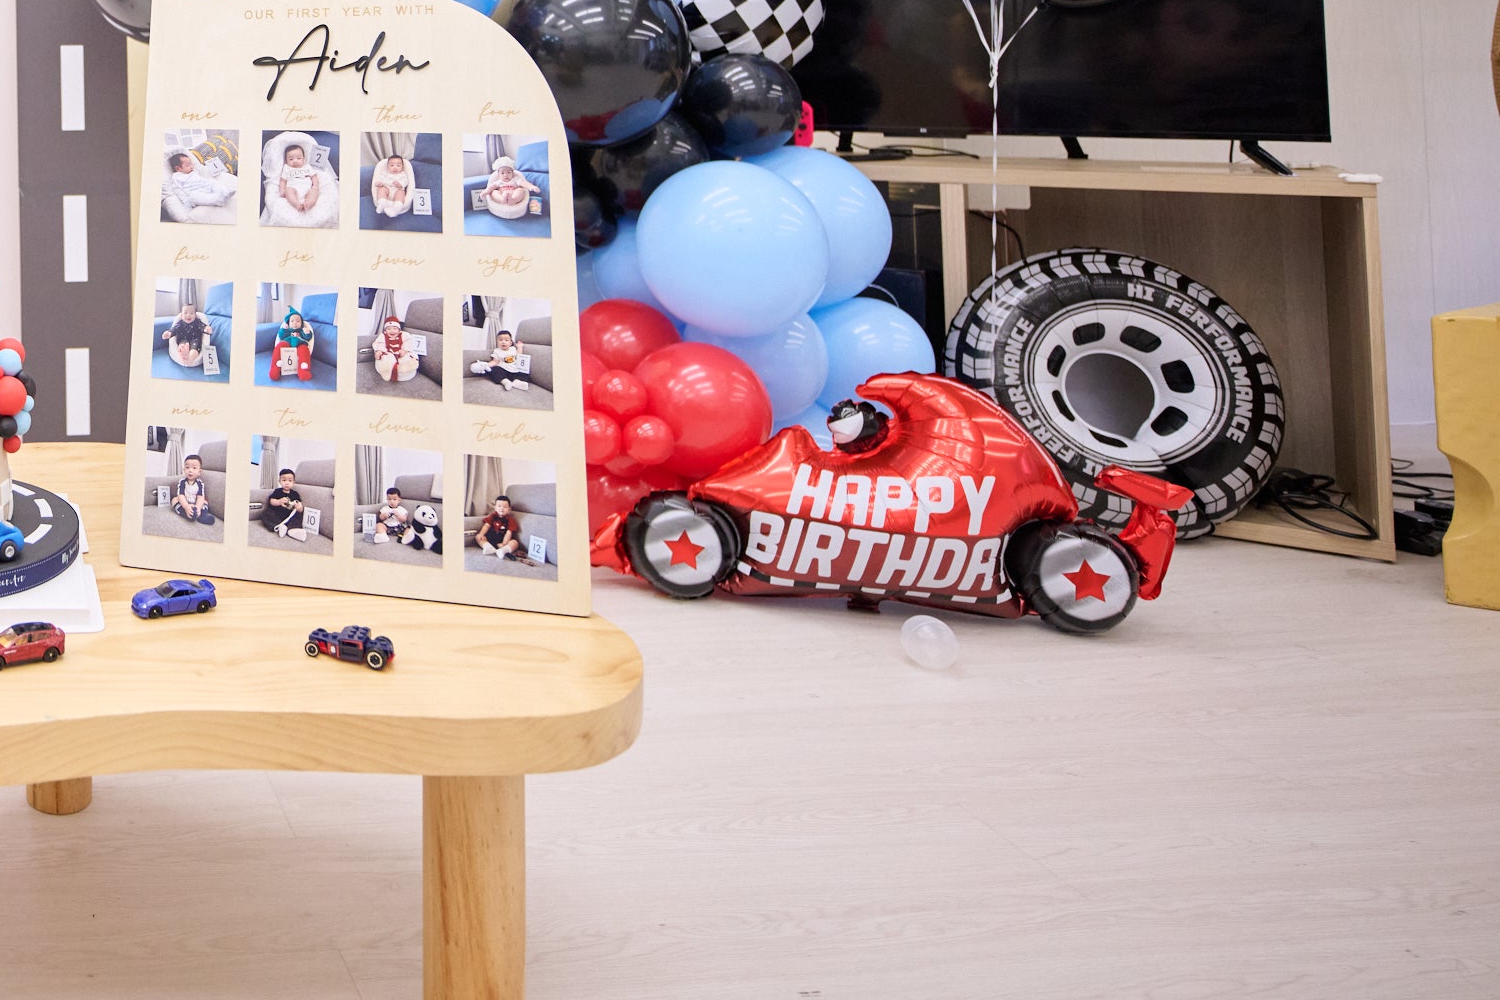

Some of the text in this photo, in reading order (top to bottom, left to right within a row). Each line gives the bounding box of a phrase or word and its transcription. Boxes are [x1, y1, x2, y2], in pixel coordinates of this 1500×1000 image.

[244, 5, 435, 20] OUR FIRST YEAR WITH
[253, 23, 430, 102] Aiden
[181, 110, 218, 122] one
[281, 105, 318, 124] two
[372, 104, 422, 123] three
[478, 101, 521, 120] four
[315, 153, 322, 164] 2
[419, 196, 425, 207] 3
[173, 246, 210, 267] five
[278, 248, 315, 268] six
[371, 252, 426, 269] seven
[477, 255, 533, 278] eight
[208, 353, 214, 366] 5
[287, 355, 293, 366] 6
[1127, 282, 1254, 444] HI FERFORMANCE
[1004, 316, 1075, 463] FERFORMANCE
[171, 406, 213, 416] nine
[275, 406, 313, 429] ten
[368, 411, 430, 436] eleven
[472, 420, 546, 443] twelve
[786, 463, 997, 536] HAPPY
[307, 514, 316, 526] 10
[532, 542, 541, 554] 12
